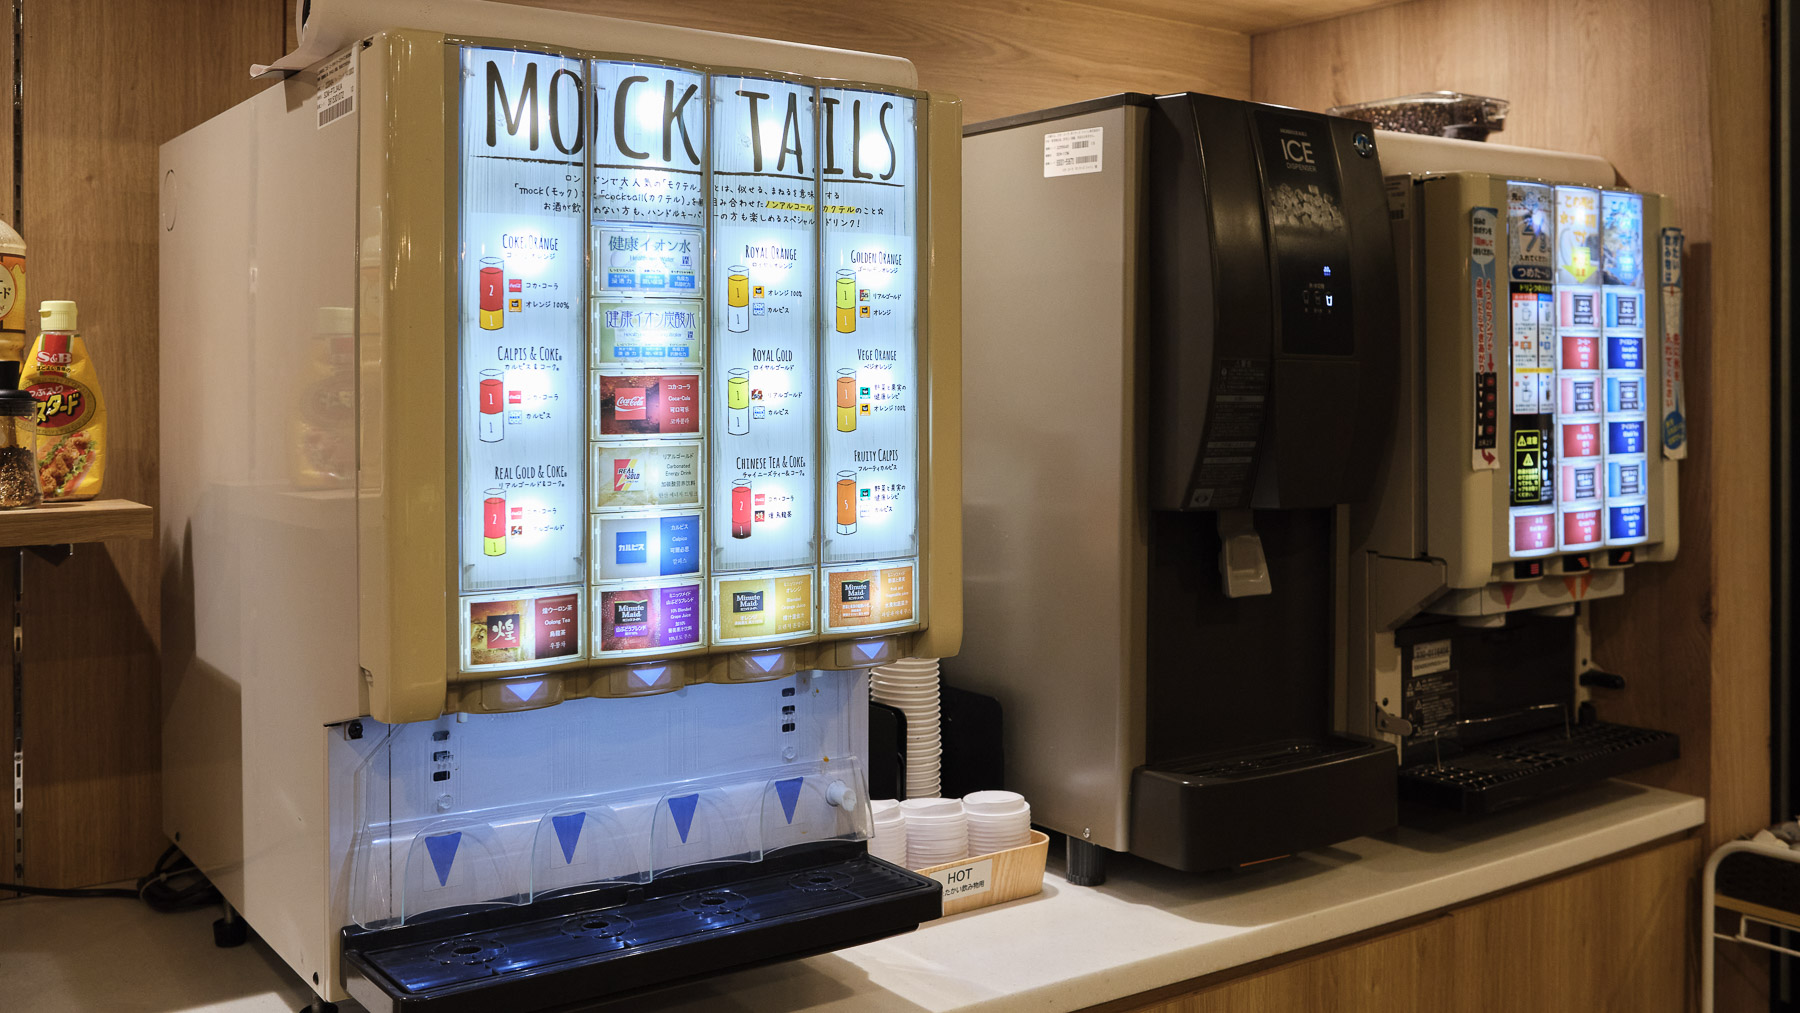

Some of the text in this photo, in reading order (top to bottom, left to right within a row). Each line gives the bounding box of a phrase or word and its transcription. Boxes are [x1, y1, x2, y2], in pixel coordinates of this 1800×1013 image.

[485, 60, 896, 180] MOCK TAILS
[1280, 138, 1316, 164] ICE
[1286, 162, 1317, 172] DISPENSER
[607, 235, 691, 254] 健康イオン水
[745, 244, 797, 261] ROYAL ORANGE
[850, 249, 902, 266] GOLDEN ORANGE
[488, 284, 495, 297] 2
[843, 290, 848, 301] 1
[767, 306, 790, 314] カルピス
[489, 314, 494, 327] 1
[843, 315, 848, 326] 1
[37, 351, 72, 363] S&B
[497, 345, 528, 361] CALPIS
[529, 346, 538, 361] &
[752, 347, 793, 362] ROYAL GOLD
[857, 348, 897, 362] VEGE ORANGE
[488, 393, 495, 405] 1
[844, 388, 848, 401] 1
[25, 392, 81, 425] スタード
[768, 408, 790, 416] カルピス
[526, 411, 552, 420] カルピス
[844, 415, 848, 426] 1
[488, 421, 494, 434] 1
[853, 448, 899, 462] FRUITY CALPIS
[736, 456, 767, 470] CHINESE
[768, 456, 781, 469] TEA
[781, 455, 788, 468] &
[494, 465, 514, 480] REAL
[515, 465, 536, 480] GOLD
[537, 465, 545, 479] &
[739, 500, 744, 511] 2
[492, 513, 498, 525] 2
[739, 525, 744, 536] 1
[492, 542, 497, 553] 1
[618, 543, 645, 552] カルピス
[844, 583, 867, 591] Minute
[736, 594, 761, 602] Minute
[739, 600, 758, 608] Maid
[618, 604, 645, 613] Minute
[621, 610, 643, 619] Maid
[948, 867, 973, 884] HOT
[943, 880, 985, 896] たかい飲み物用
